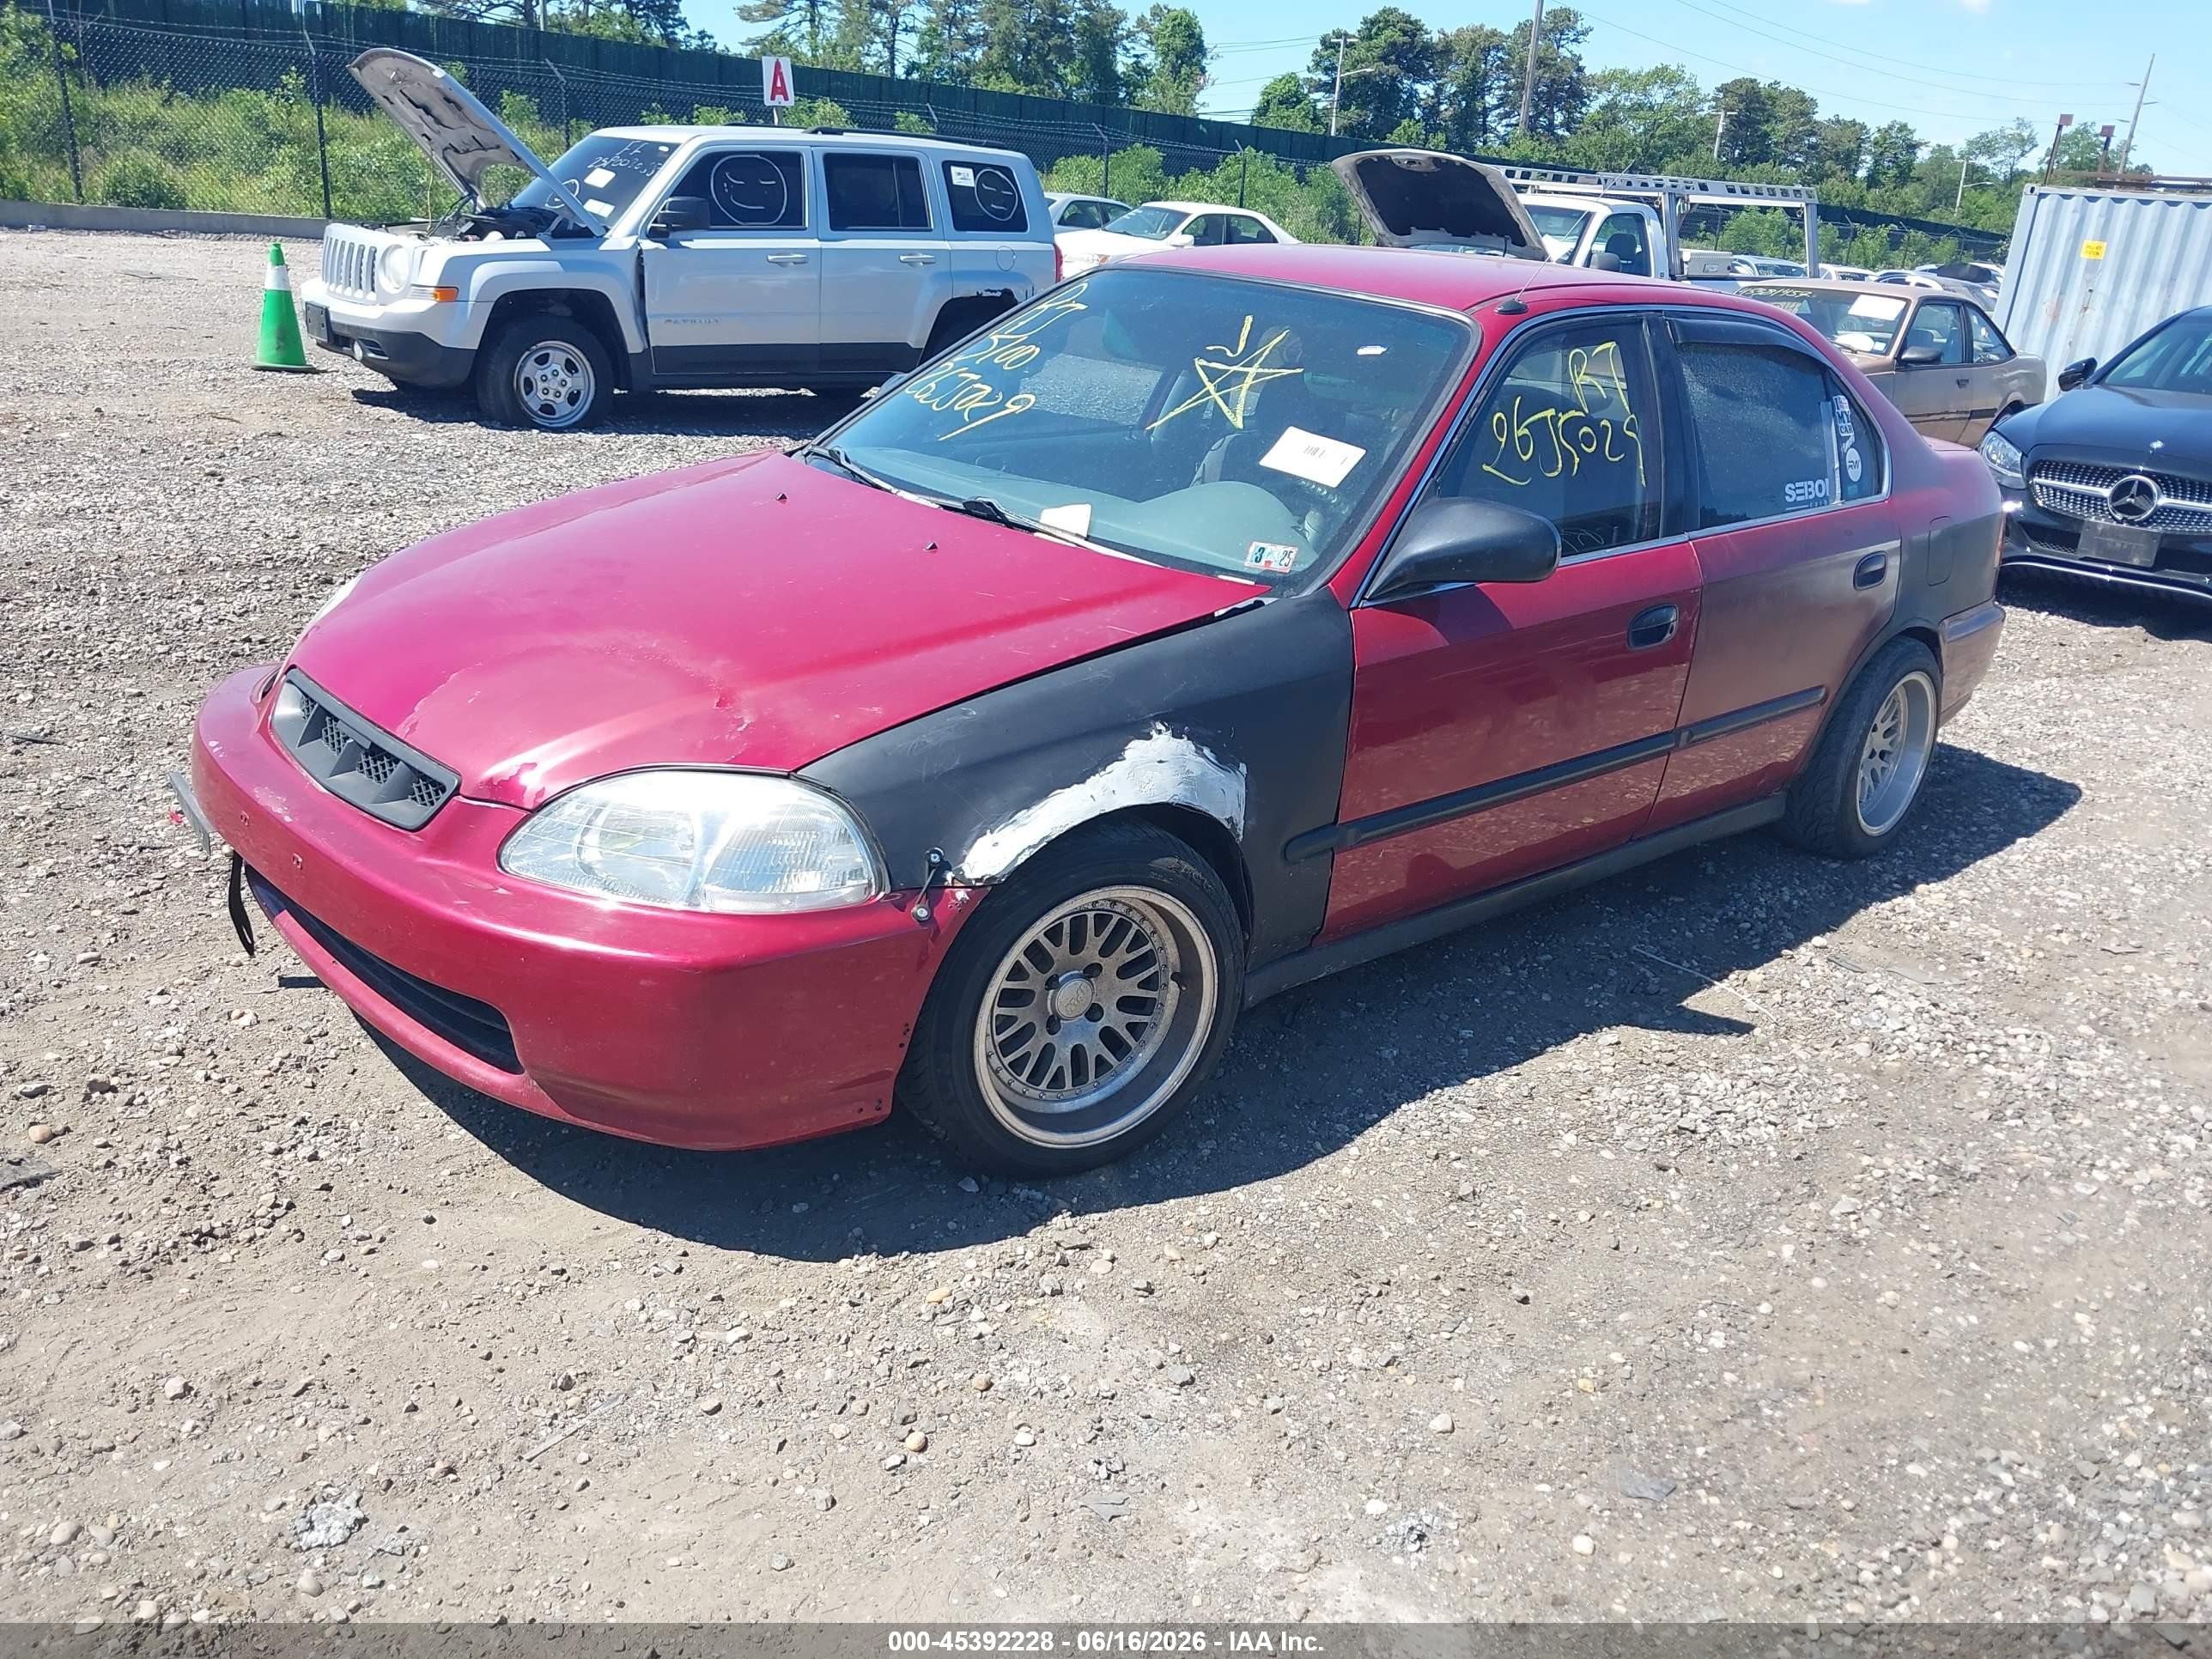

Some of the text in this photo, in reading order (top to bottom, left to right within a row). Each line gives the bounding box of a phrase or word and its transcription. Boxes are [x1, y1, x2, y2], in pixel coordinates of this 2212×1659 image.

[770, 58, 788, 100] A
[1838, 411, 1850, 423] MY
[1839, 425, 1853, 434] CAR
[1255, 547, 1293, 567] 3 25
